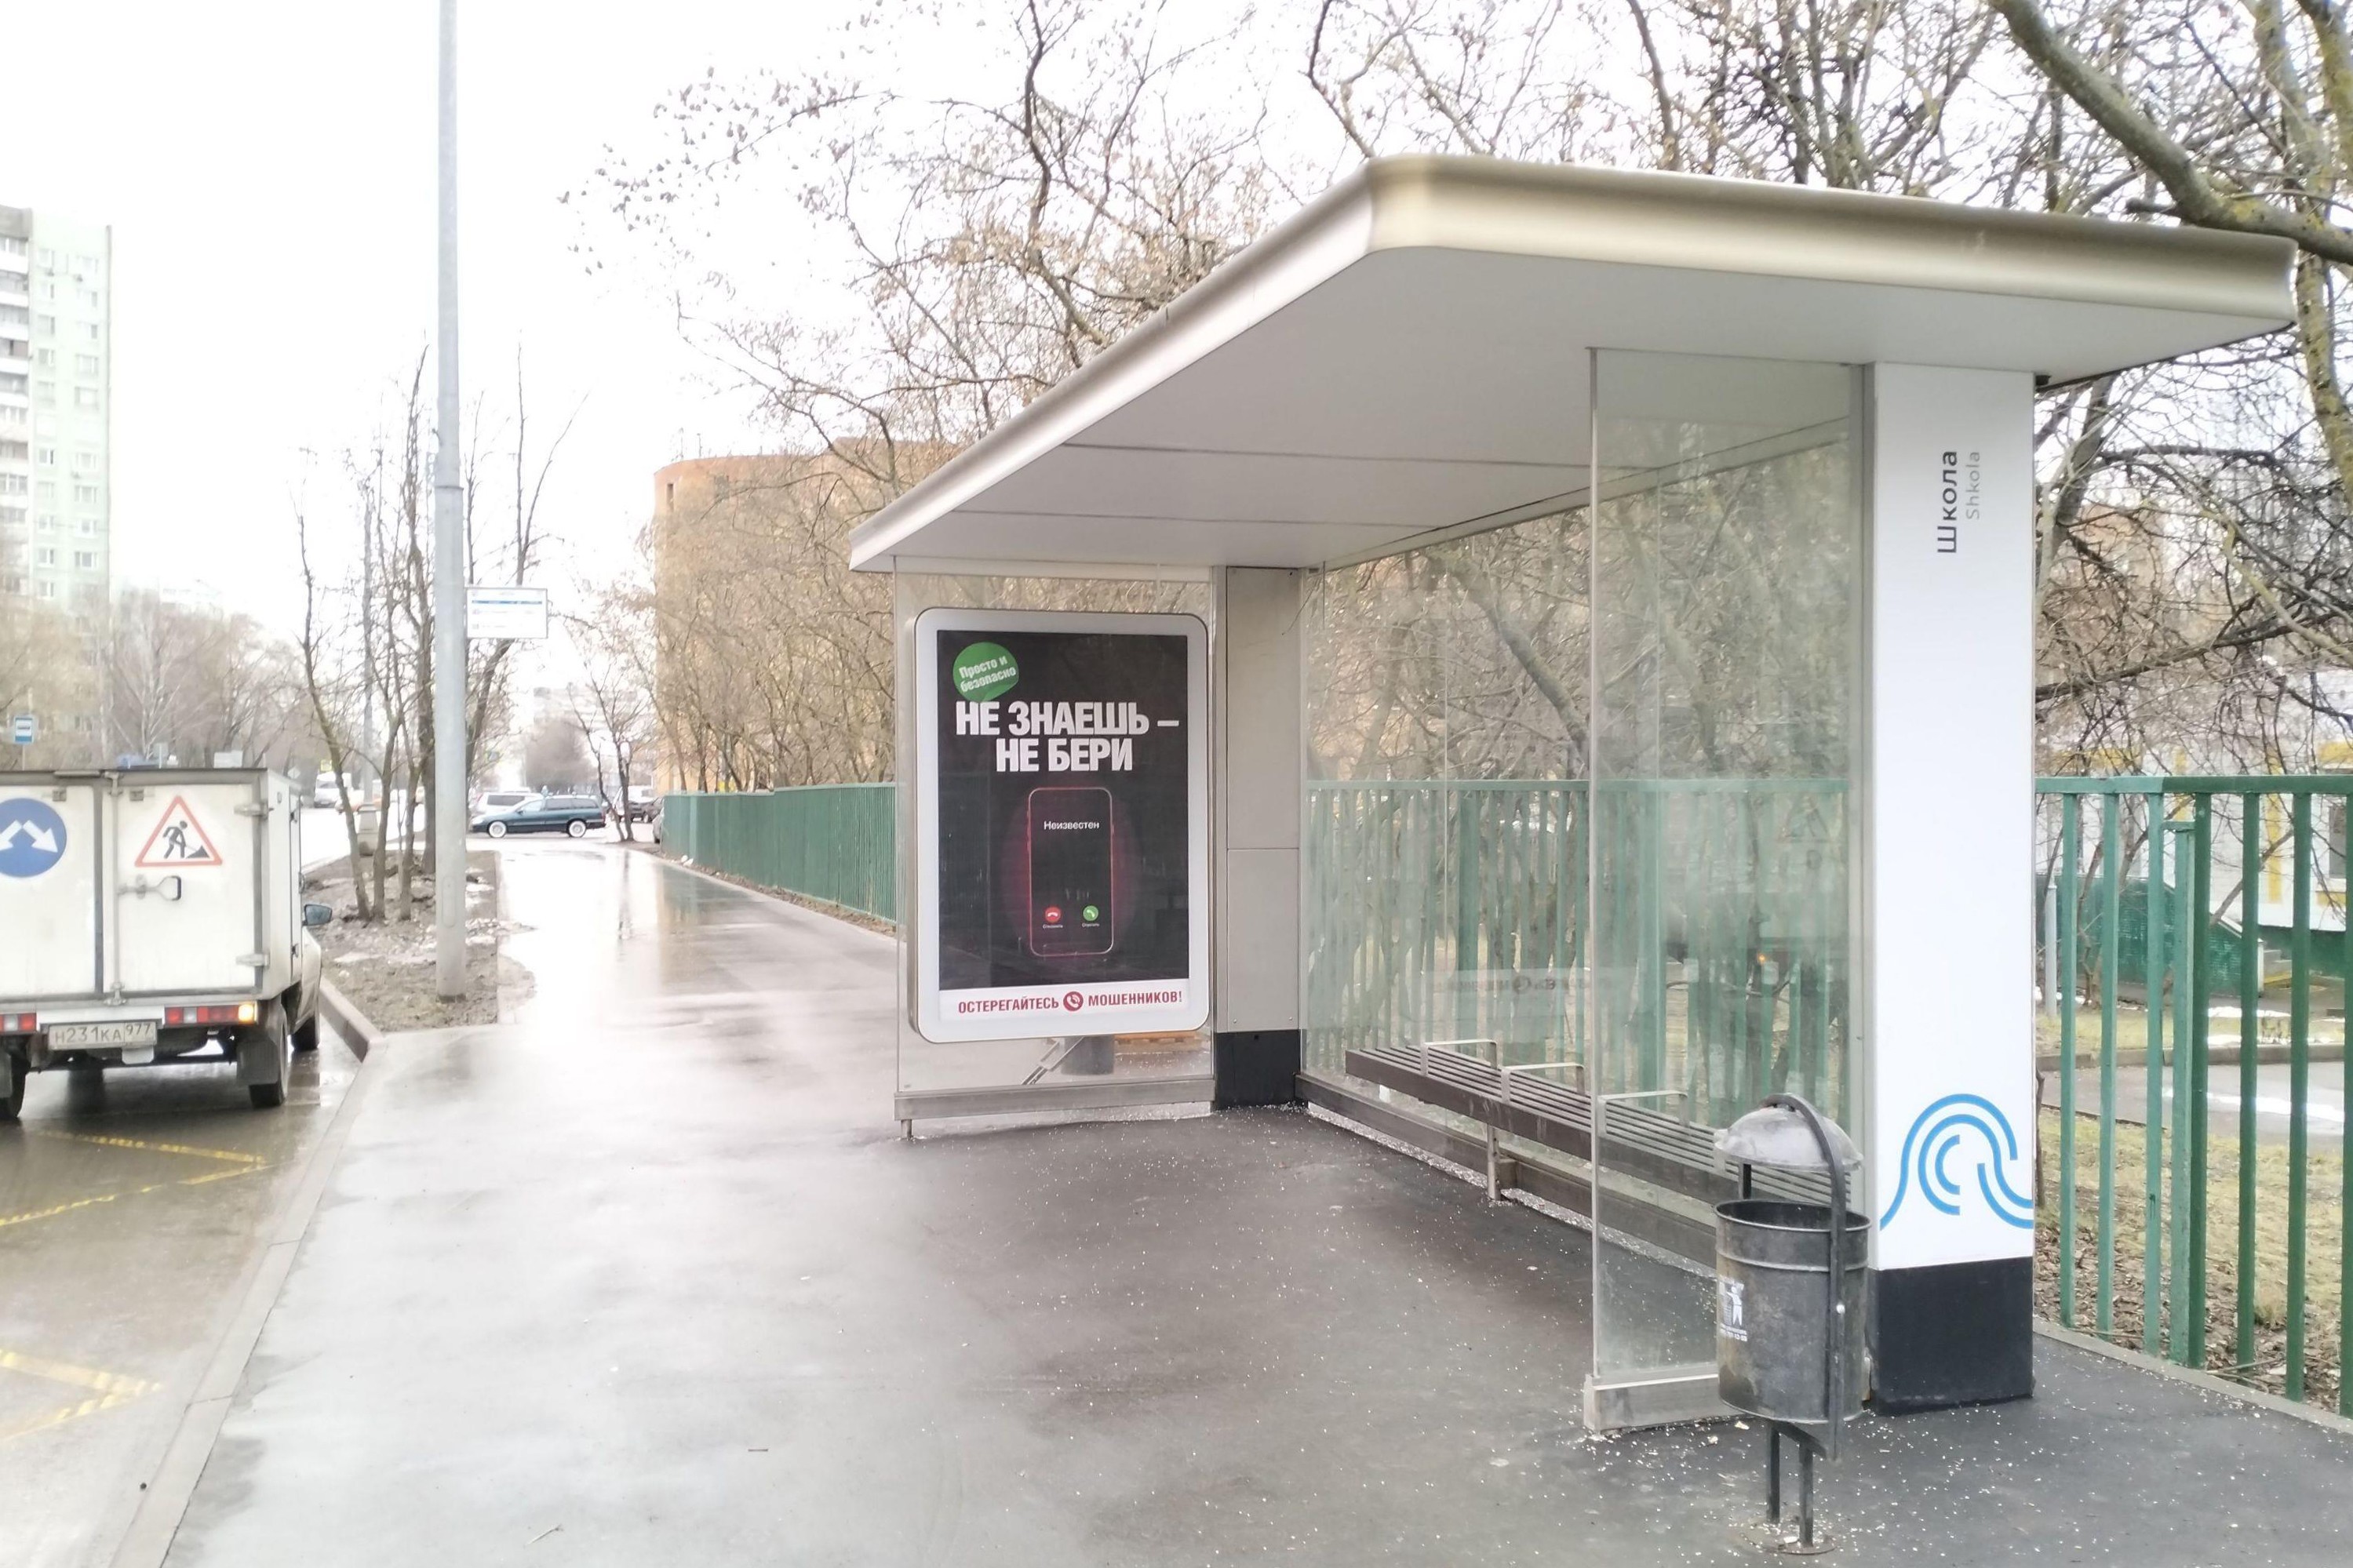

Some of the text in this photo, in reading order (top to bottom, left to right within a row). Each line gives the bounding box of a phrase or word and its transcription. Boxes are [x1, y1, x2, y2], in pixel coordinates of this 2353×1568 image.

[1965, 451, 1980, 520] Shkola
[1936, 451, 1957, 553] Школа
[959, 656, 1008, 679] Просто и
[960, 667, 1017, 693] безопасно
[956, 700, 1000, 736] НЕ
[1007, 700, 1150, 736] ЗНАЕШЬ
[996, 737, 1133, 772] НЕ БЕРИ
[1044, 820, 1100, 830] Неизвестен
[958, 991, 1182, 1013] ОСТЕРЕГАЙТЕСЬ МОШЕННИКОВ!
